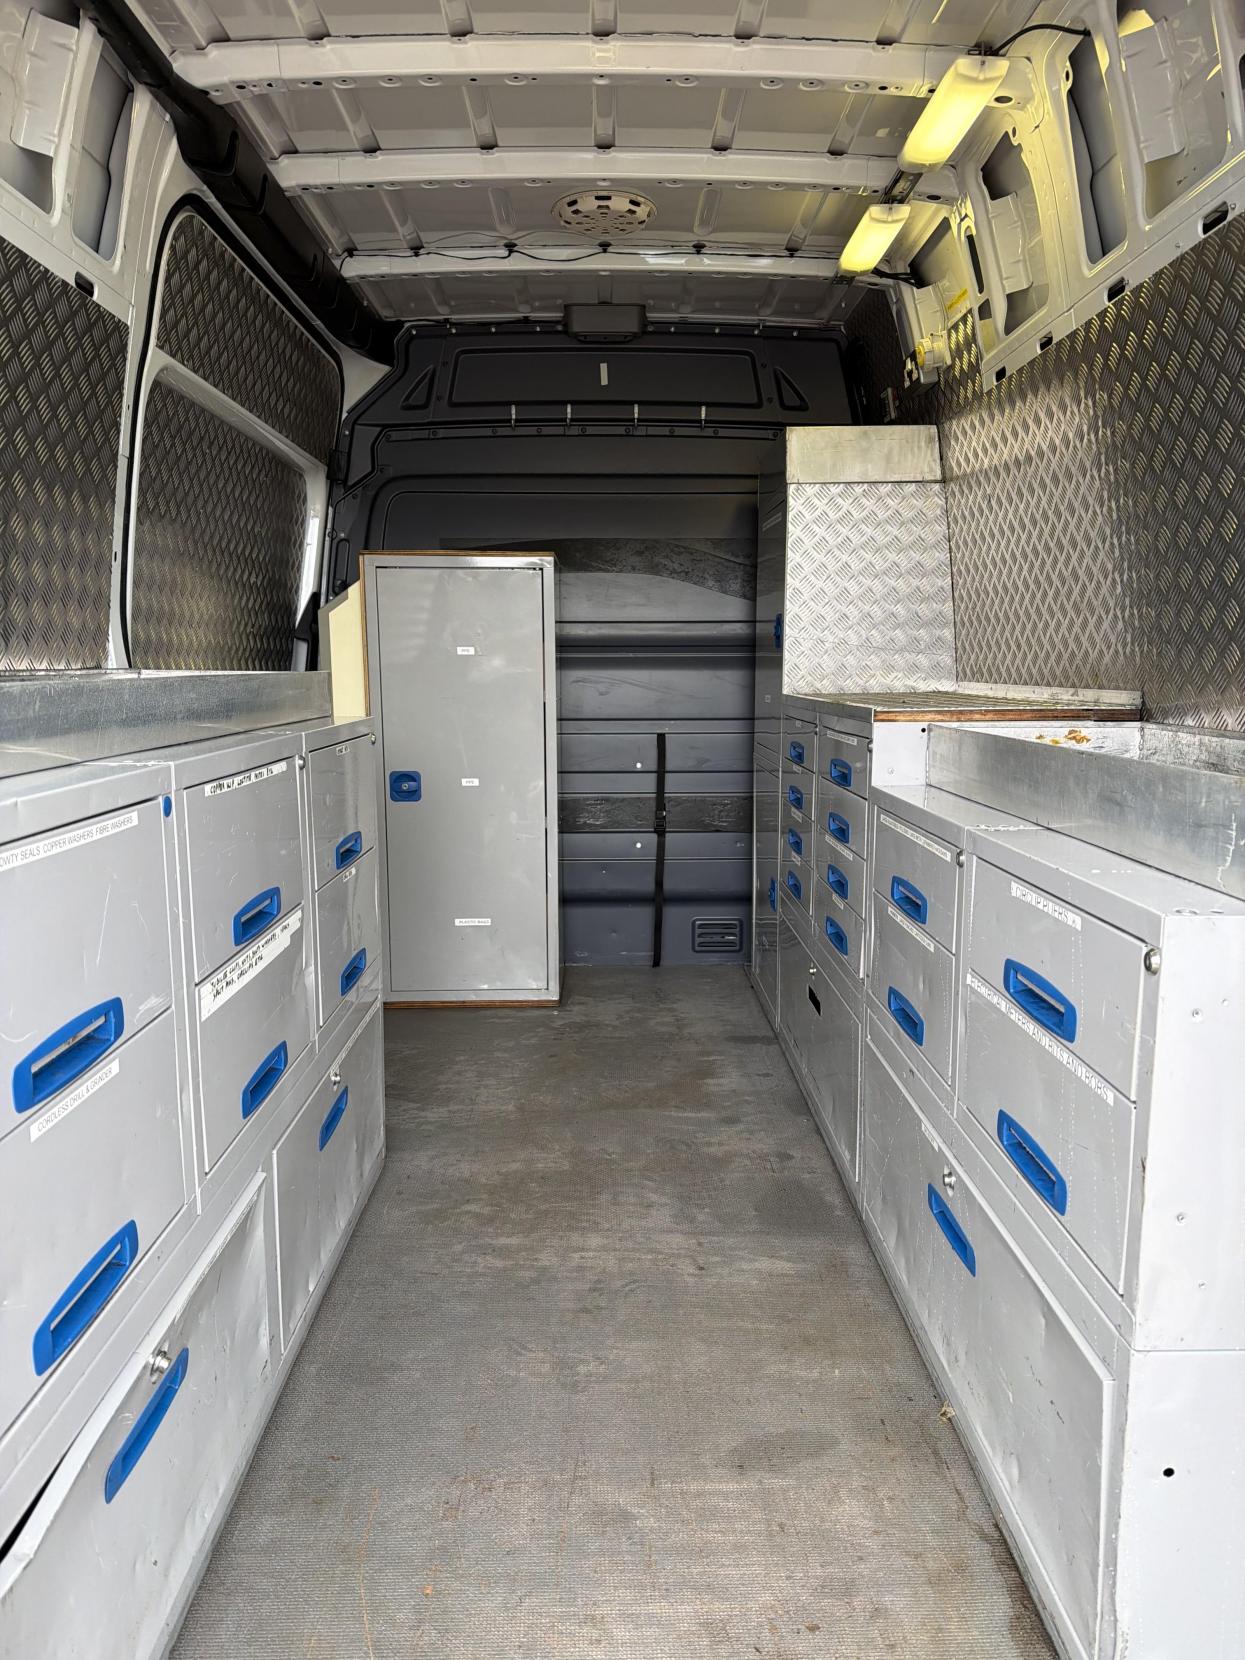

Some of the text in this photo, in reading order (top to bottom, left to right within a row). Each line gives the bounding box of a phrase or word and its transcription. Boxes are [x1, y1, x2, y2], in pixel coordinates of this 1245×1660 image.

[20, 846, 41, 861] SEALS
[43, 838, 67, 854] COPPER
[68, 829, 95, 845] WASHERS
[95, 823, 110, 837] FIBRE
[110, 815, 133, 830] WASHERS
[37, 1101, 69, 1132] CORDLESS
[69, 1090, 85, 1107] DRILL
[90, 1066, 113, 1090] GRINDER
